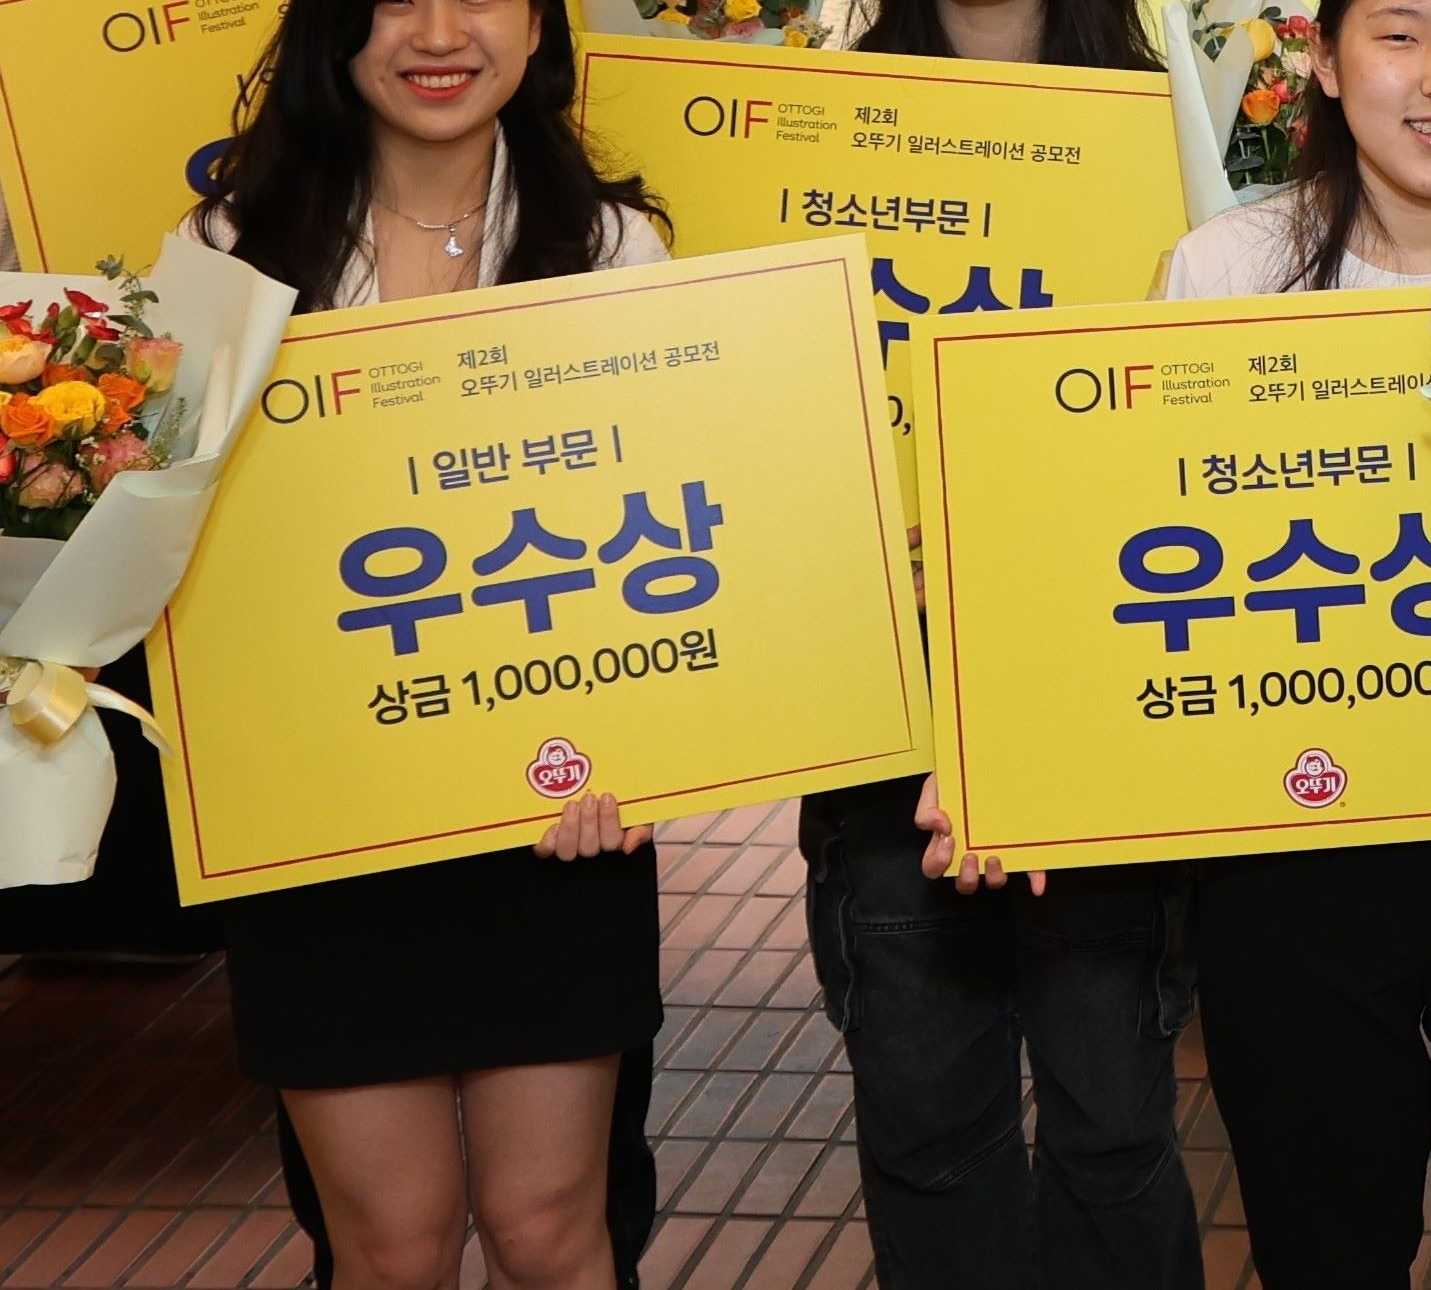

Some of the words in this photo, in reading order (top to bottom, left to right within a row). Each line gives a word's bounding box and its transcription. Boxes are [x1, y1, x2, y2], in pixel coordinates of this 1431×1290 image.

[197, 2, 259, 21] Illustration
[102, 0, 190, 52] OIF
[200, 16, 247, 34] Festival
[684, 96, 772, 138] OIF
[778, 103, 825, 116] OTTOGI
[854, 106, 898, 127] 제2회
[777, 117, 837, 130] Illustration
[776, 130, 820, 143] Festival
[851, 132, 901, 152] 오뚜기
[908, 135, 1024, 161] 일러스트레이션
[1031, 144, 1080, 165] 공모전
[802, 189, 970, 235] 청소년부문
[457, 345, 508, 369] 제2회
[1248, 353, 1297, 375] 제2회
[368, 361, 423, 379] OTTOGI
[461, 371, 517, 397] 오뚜기
[524, 350, 658, 389] 일러스트레이션
[664, 341, 720, 367] 공모전
[1161, 362, 1214, 379] OTTOGI
[370, 376, 441, 393] Illustration
[1055, 365, 1154, 413] OIF
[1162, 377, 1230, 395] Illustration
[1249, 381, 1304, 403] 오뚜기
[260, 369, 361, 424] OIF
[372, 391, 424, 409] Festival
[1163, 392, 1212, 405] Festival
[433, 443, 511, 490] 일반
[522, 430, 598, 475] 부문
[1202, 445, 1392, 494] 청소년부문
[337, 480, 725, 657] 우수상
[368, 675, 451, 725] 상금
[462, 628, 719, 712] 1,000,000원
[1136, 675, 1217, 719] 상금
[537, 762, 582, 789] 오뚜기
[1294, 775, 1338, 797] 오뚜기
